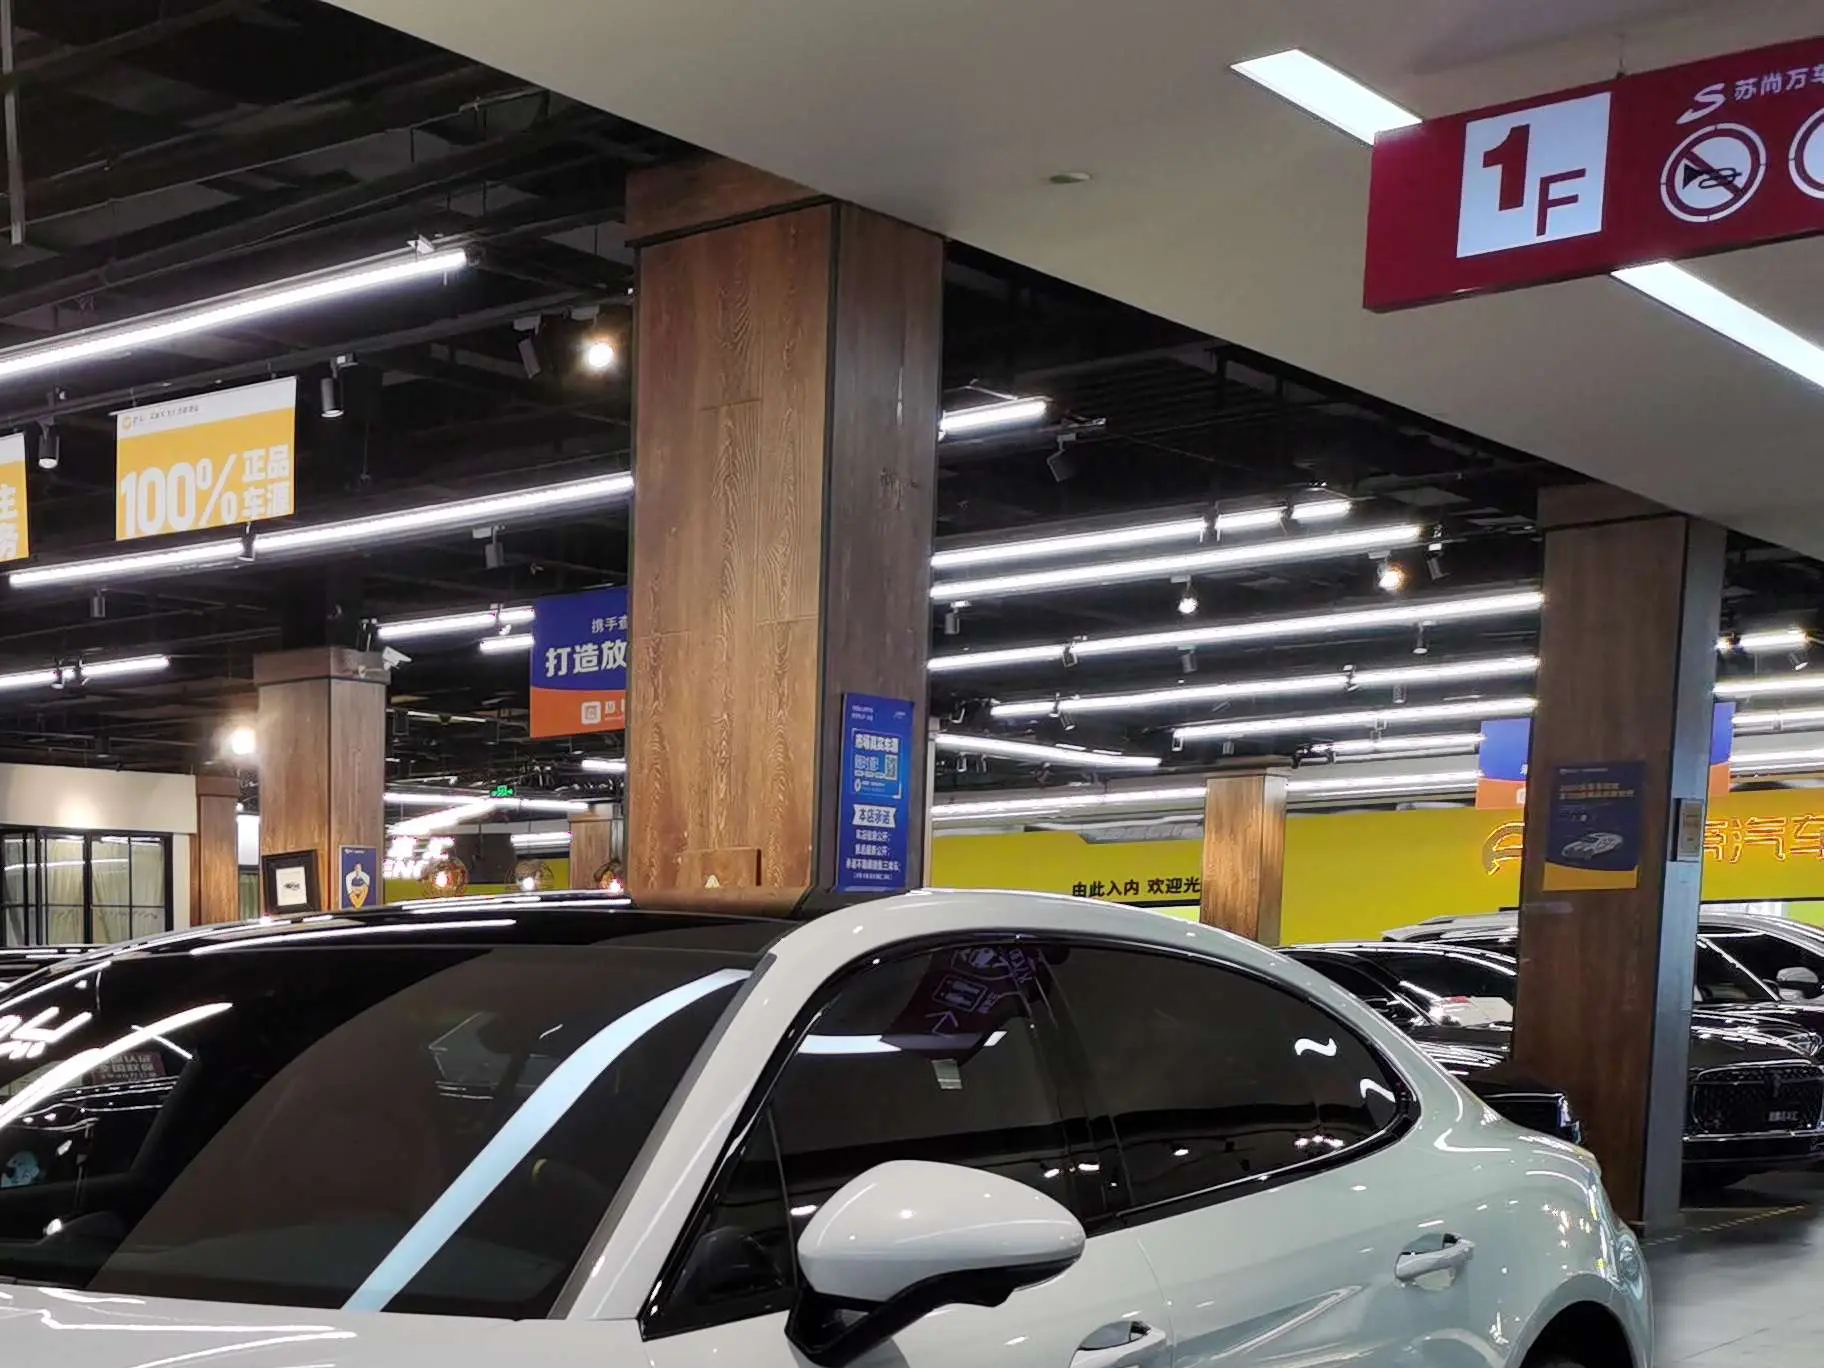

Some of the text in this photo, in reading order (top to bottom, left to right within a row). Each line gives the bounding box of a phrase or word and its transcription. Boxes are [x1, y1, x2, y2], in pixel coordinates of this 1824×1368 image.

[120, 444, 290, 538] 100% 正品
[545, 639, 627, 678] 打造放
[1072, 876, 1201, 898] 由此入内 欢迎光
